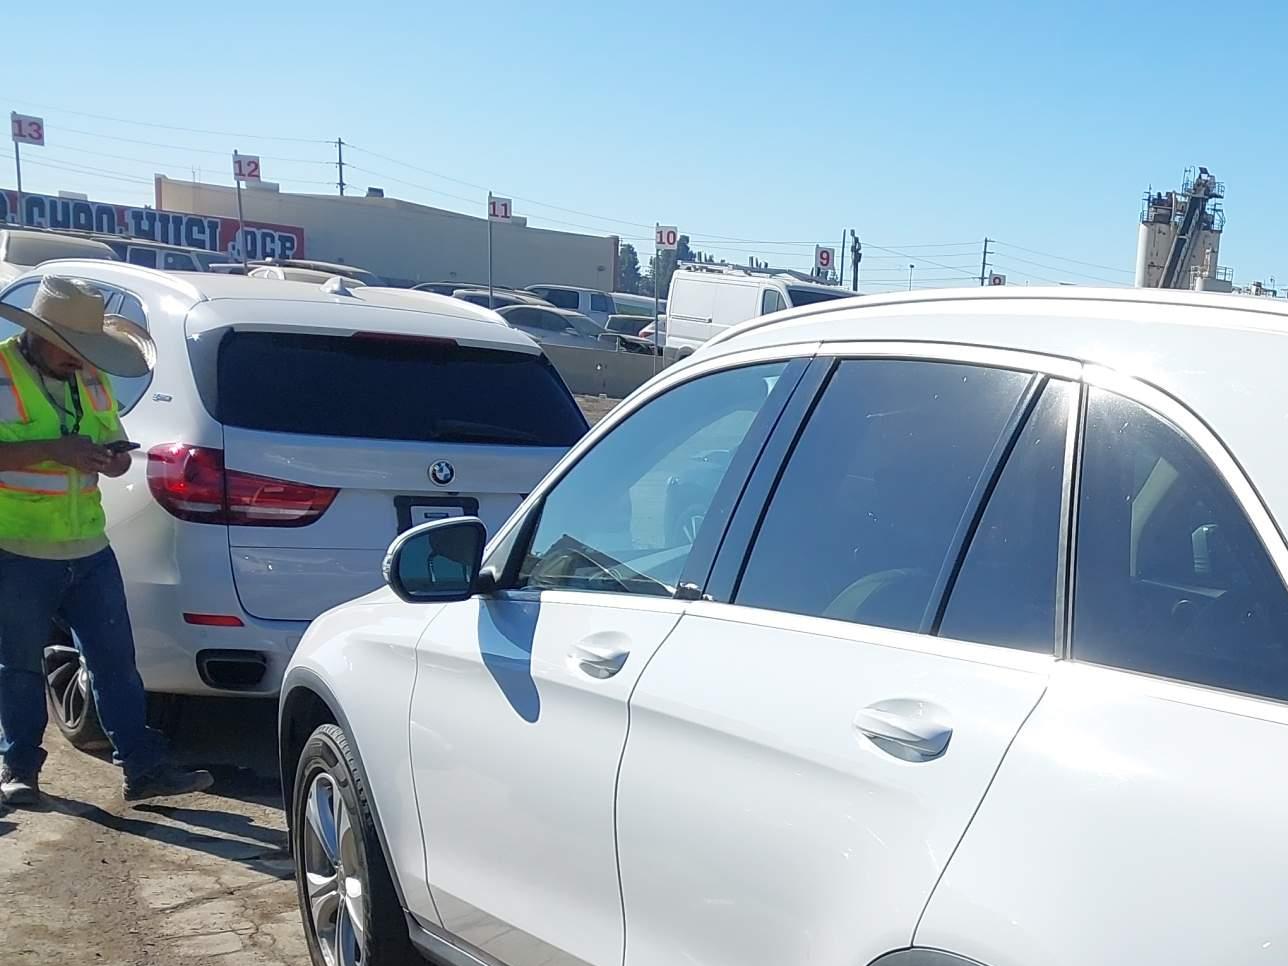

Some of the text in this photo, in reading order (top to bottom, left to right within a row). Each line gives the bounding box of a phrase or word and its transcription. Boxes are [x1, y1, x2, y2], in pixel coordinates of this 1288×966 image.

[13, 119, 43, 140] 13
[233, 159, 260, 178] 12
[489, 201, 510, 219] 11
[656, 230, 677, 246] 10
[819, 250, 830, 267] 9
